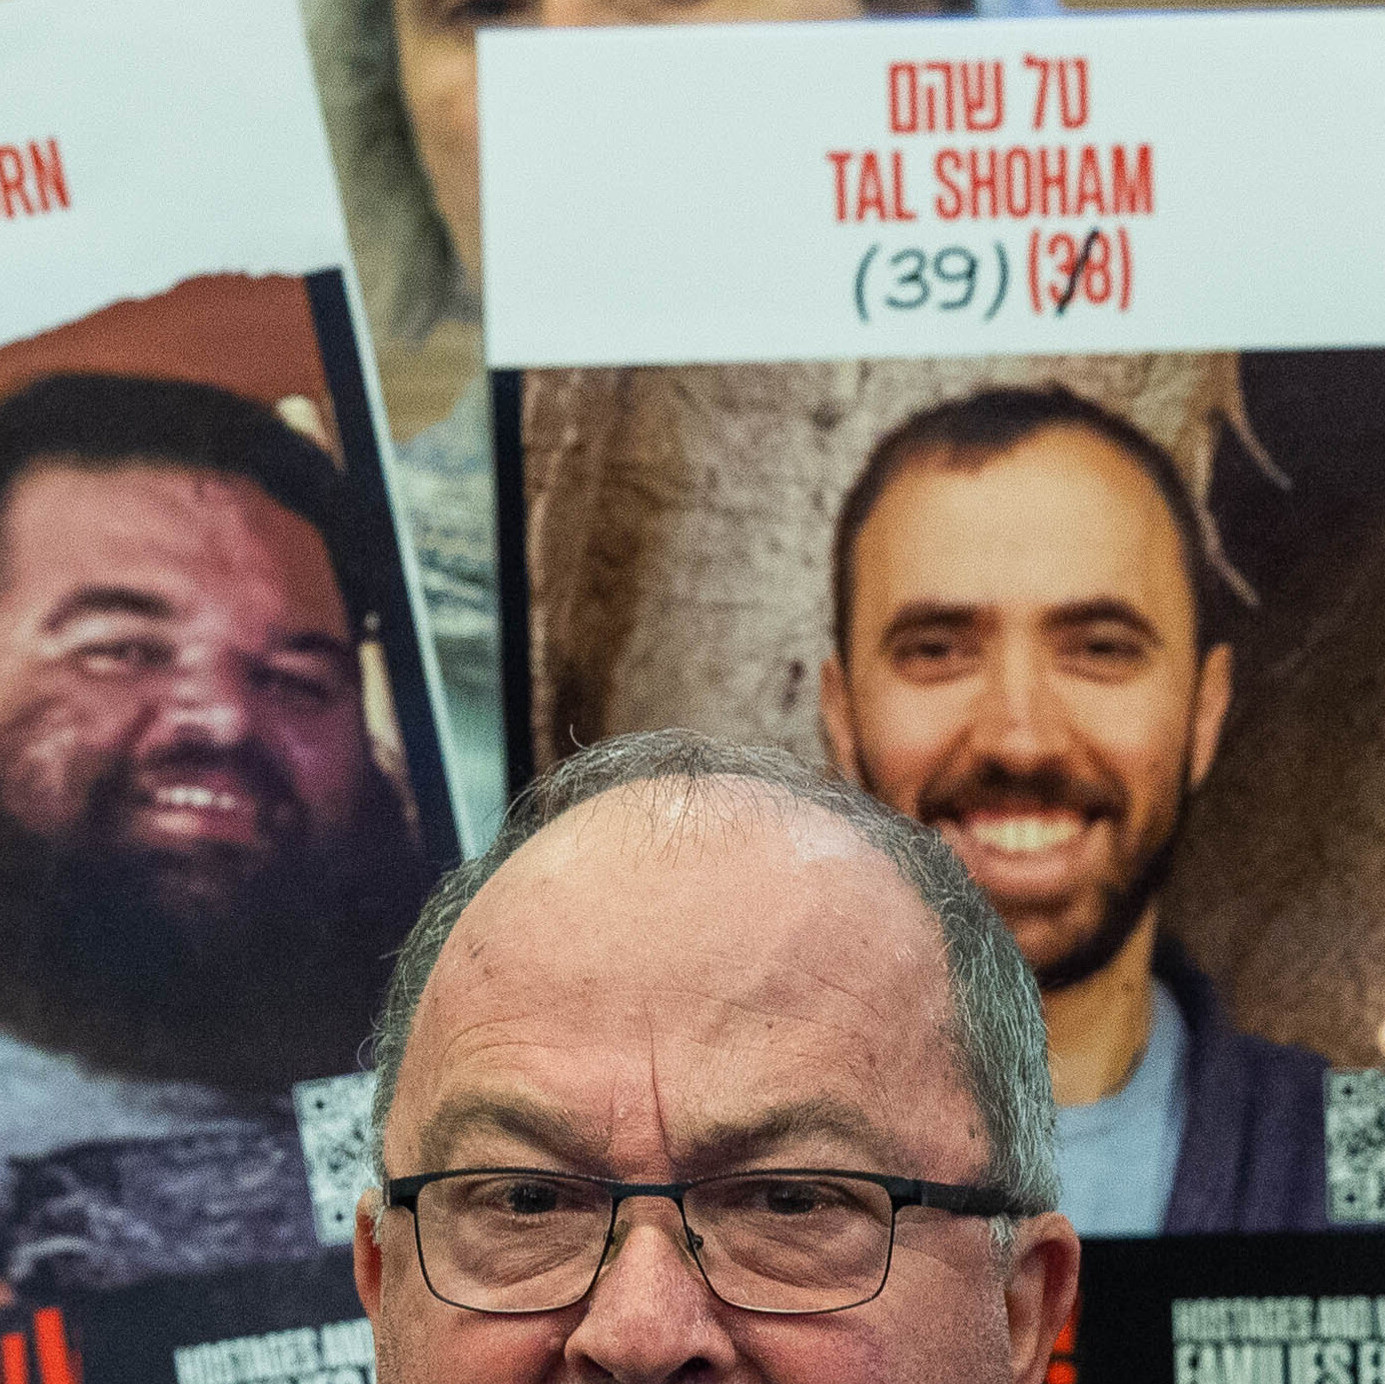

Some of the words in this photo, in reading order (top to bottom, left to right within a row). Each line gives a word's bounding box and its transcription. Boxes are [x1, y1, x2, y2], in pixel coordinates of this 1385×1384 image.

[886, 59, 1006, 135] שהם
[1022, 53, 1091, 131] טל
[826, 148, 916, 223] TAL
[932, 143, 1156, 222] SHOHAM
[854, 241, 1010, 321] (39)
